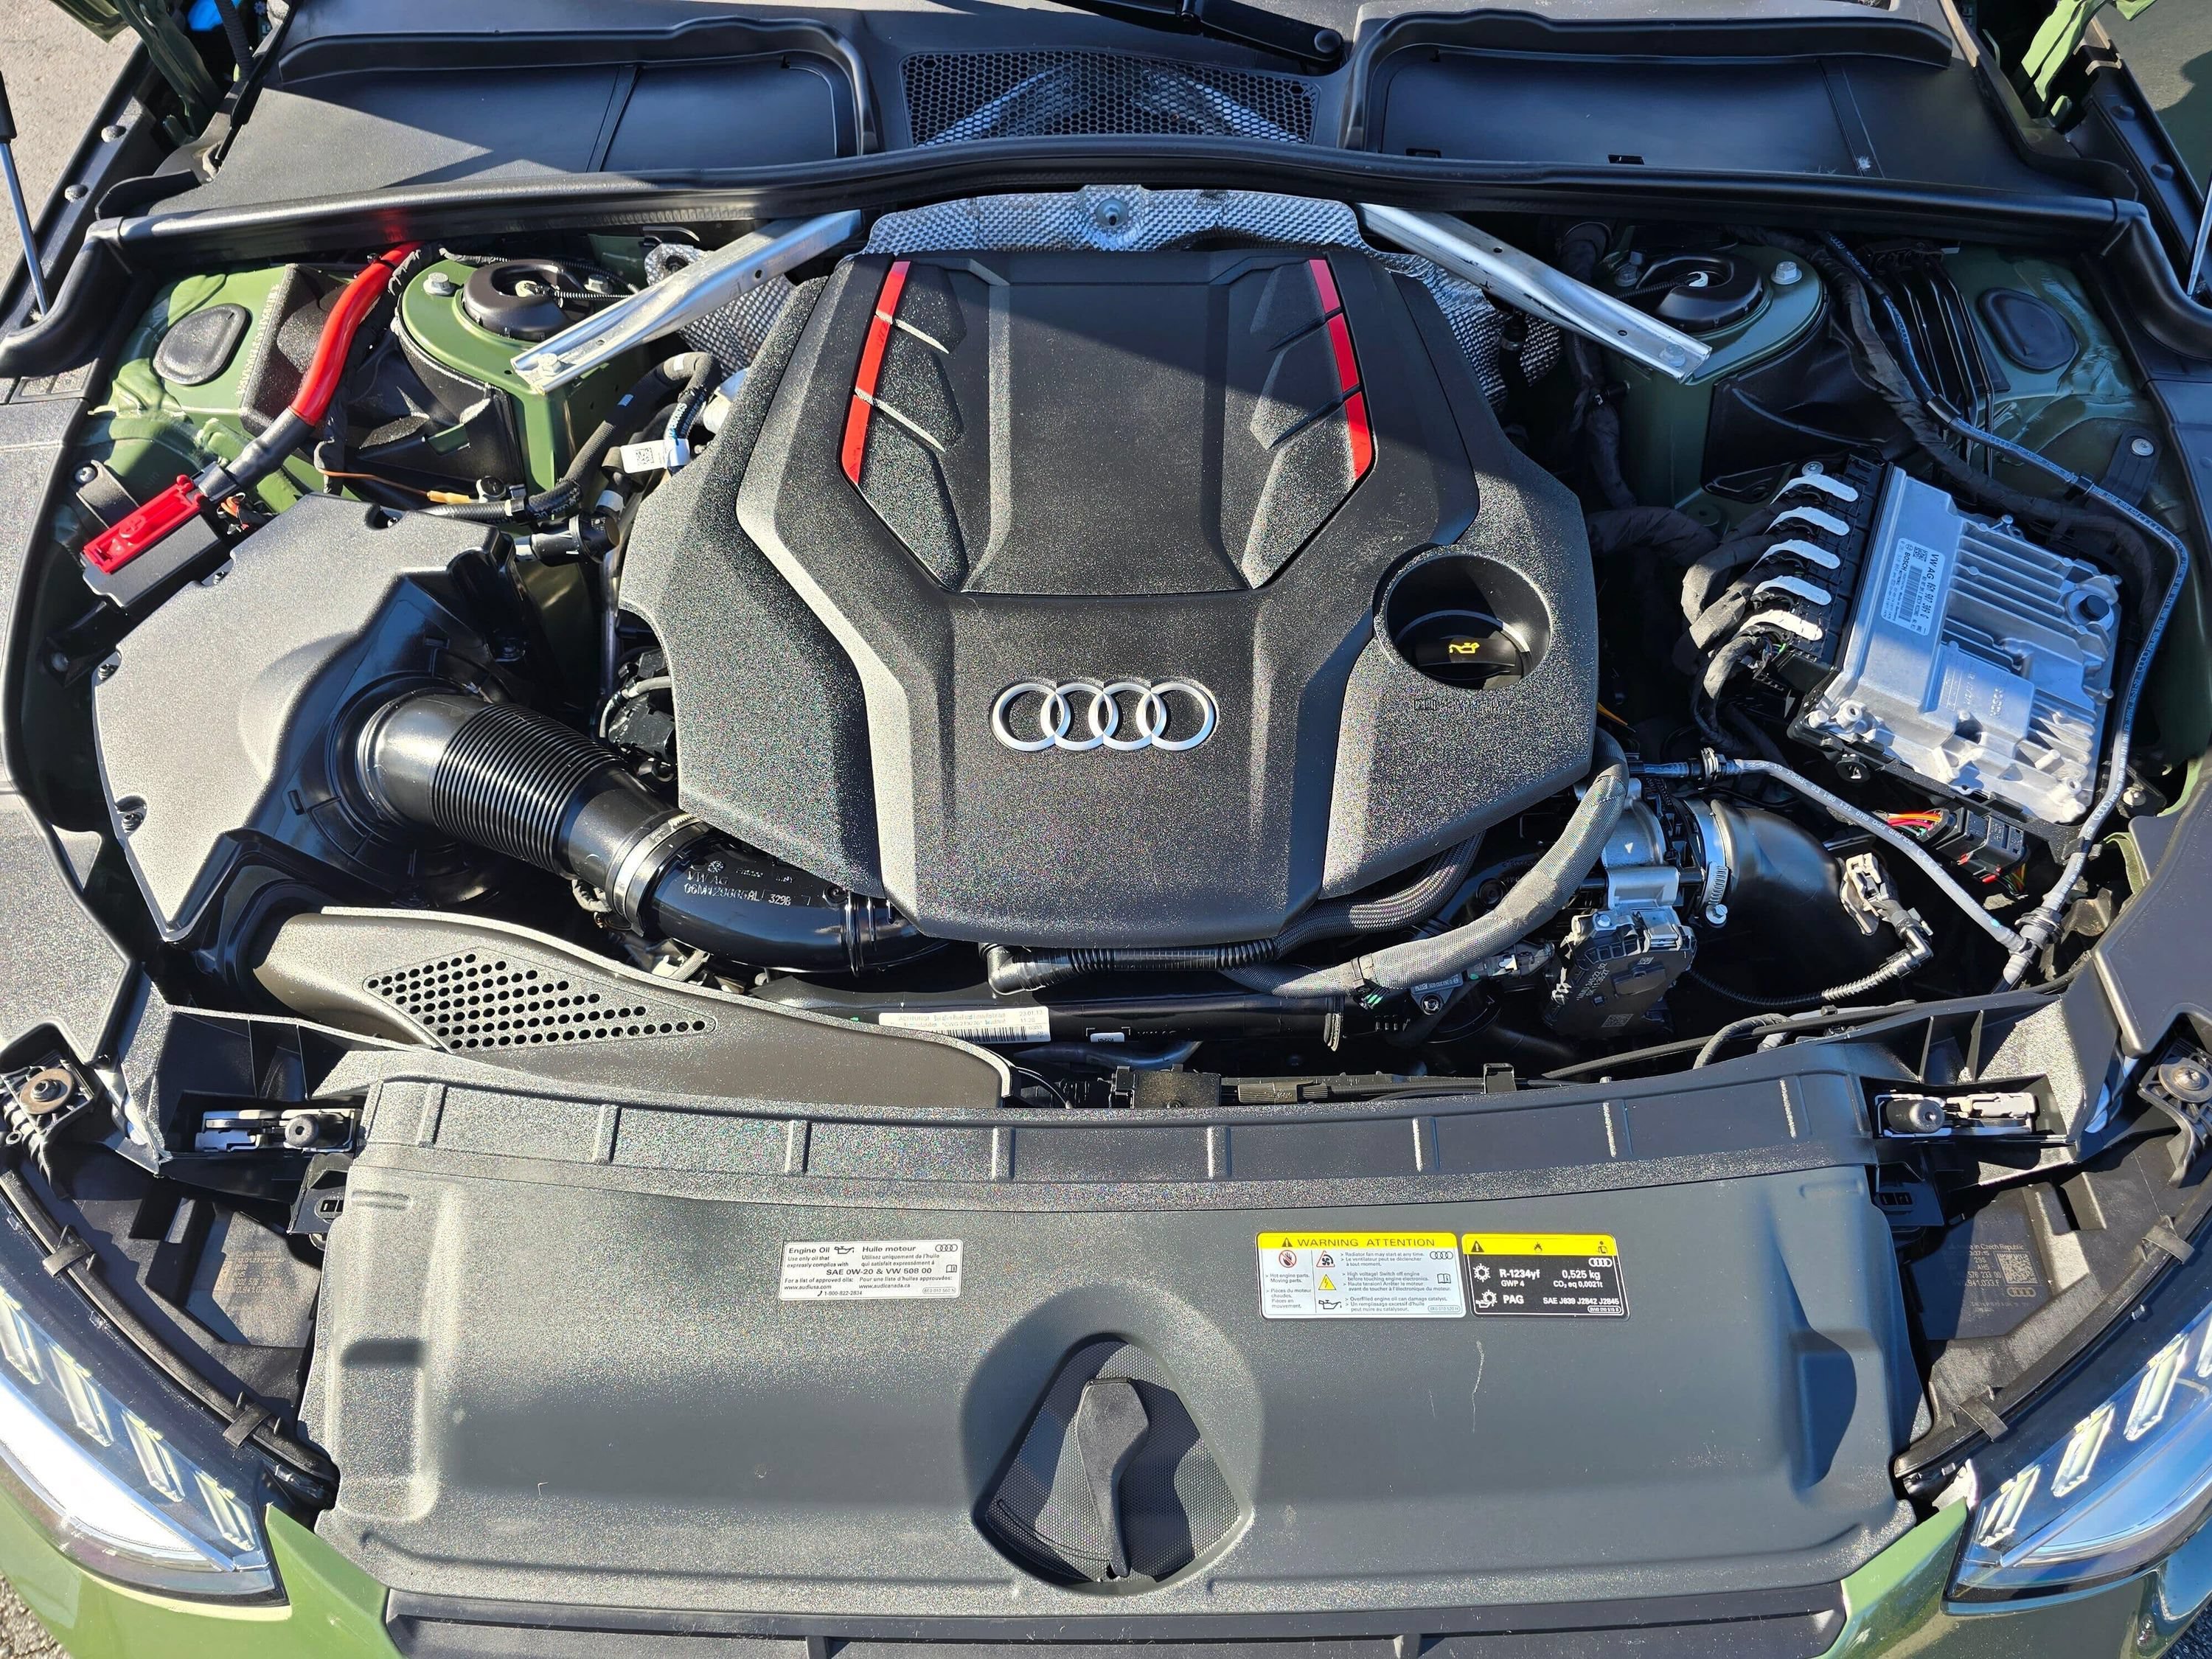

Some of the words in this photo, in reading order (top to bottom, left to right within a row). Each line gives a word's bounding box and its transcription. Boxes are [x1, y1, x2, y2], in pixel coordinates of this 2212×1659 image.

[1901, 551, 1910, 571] BOSCH
[1928, 553, 1938, 567] VW
[1925, 566, 1935, 580] AG
[1839, 801, 1852, 811] 121
[1499, 1268, 1540, 1280] R-1234yf
[1562, 1270, 1587, 1279] 0,525
[1589, 1270, 1601, 1280] kg
[1503, 1295, 1525, 1304] PAG
